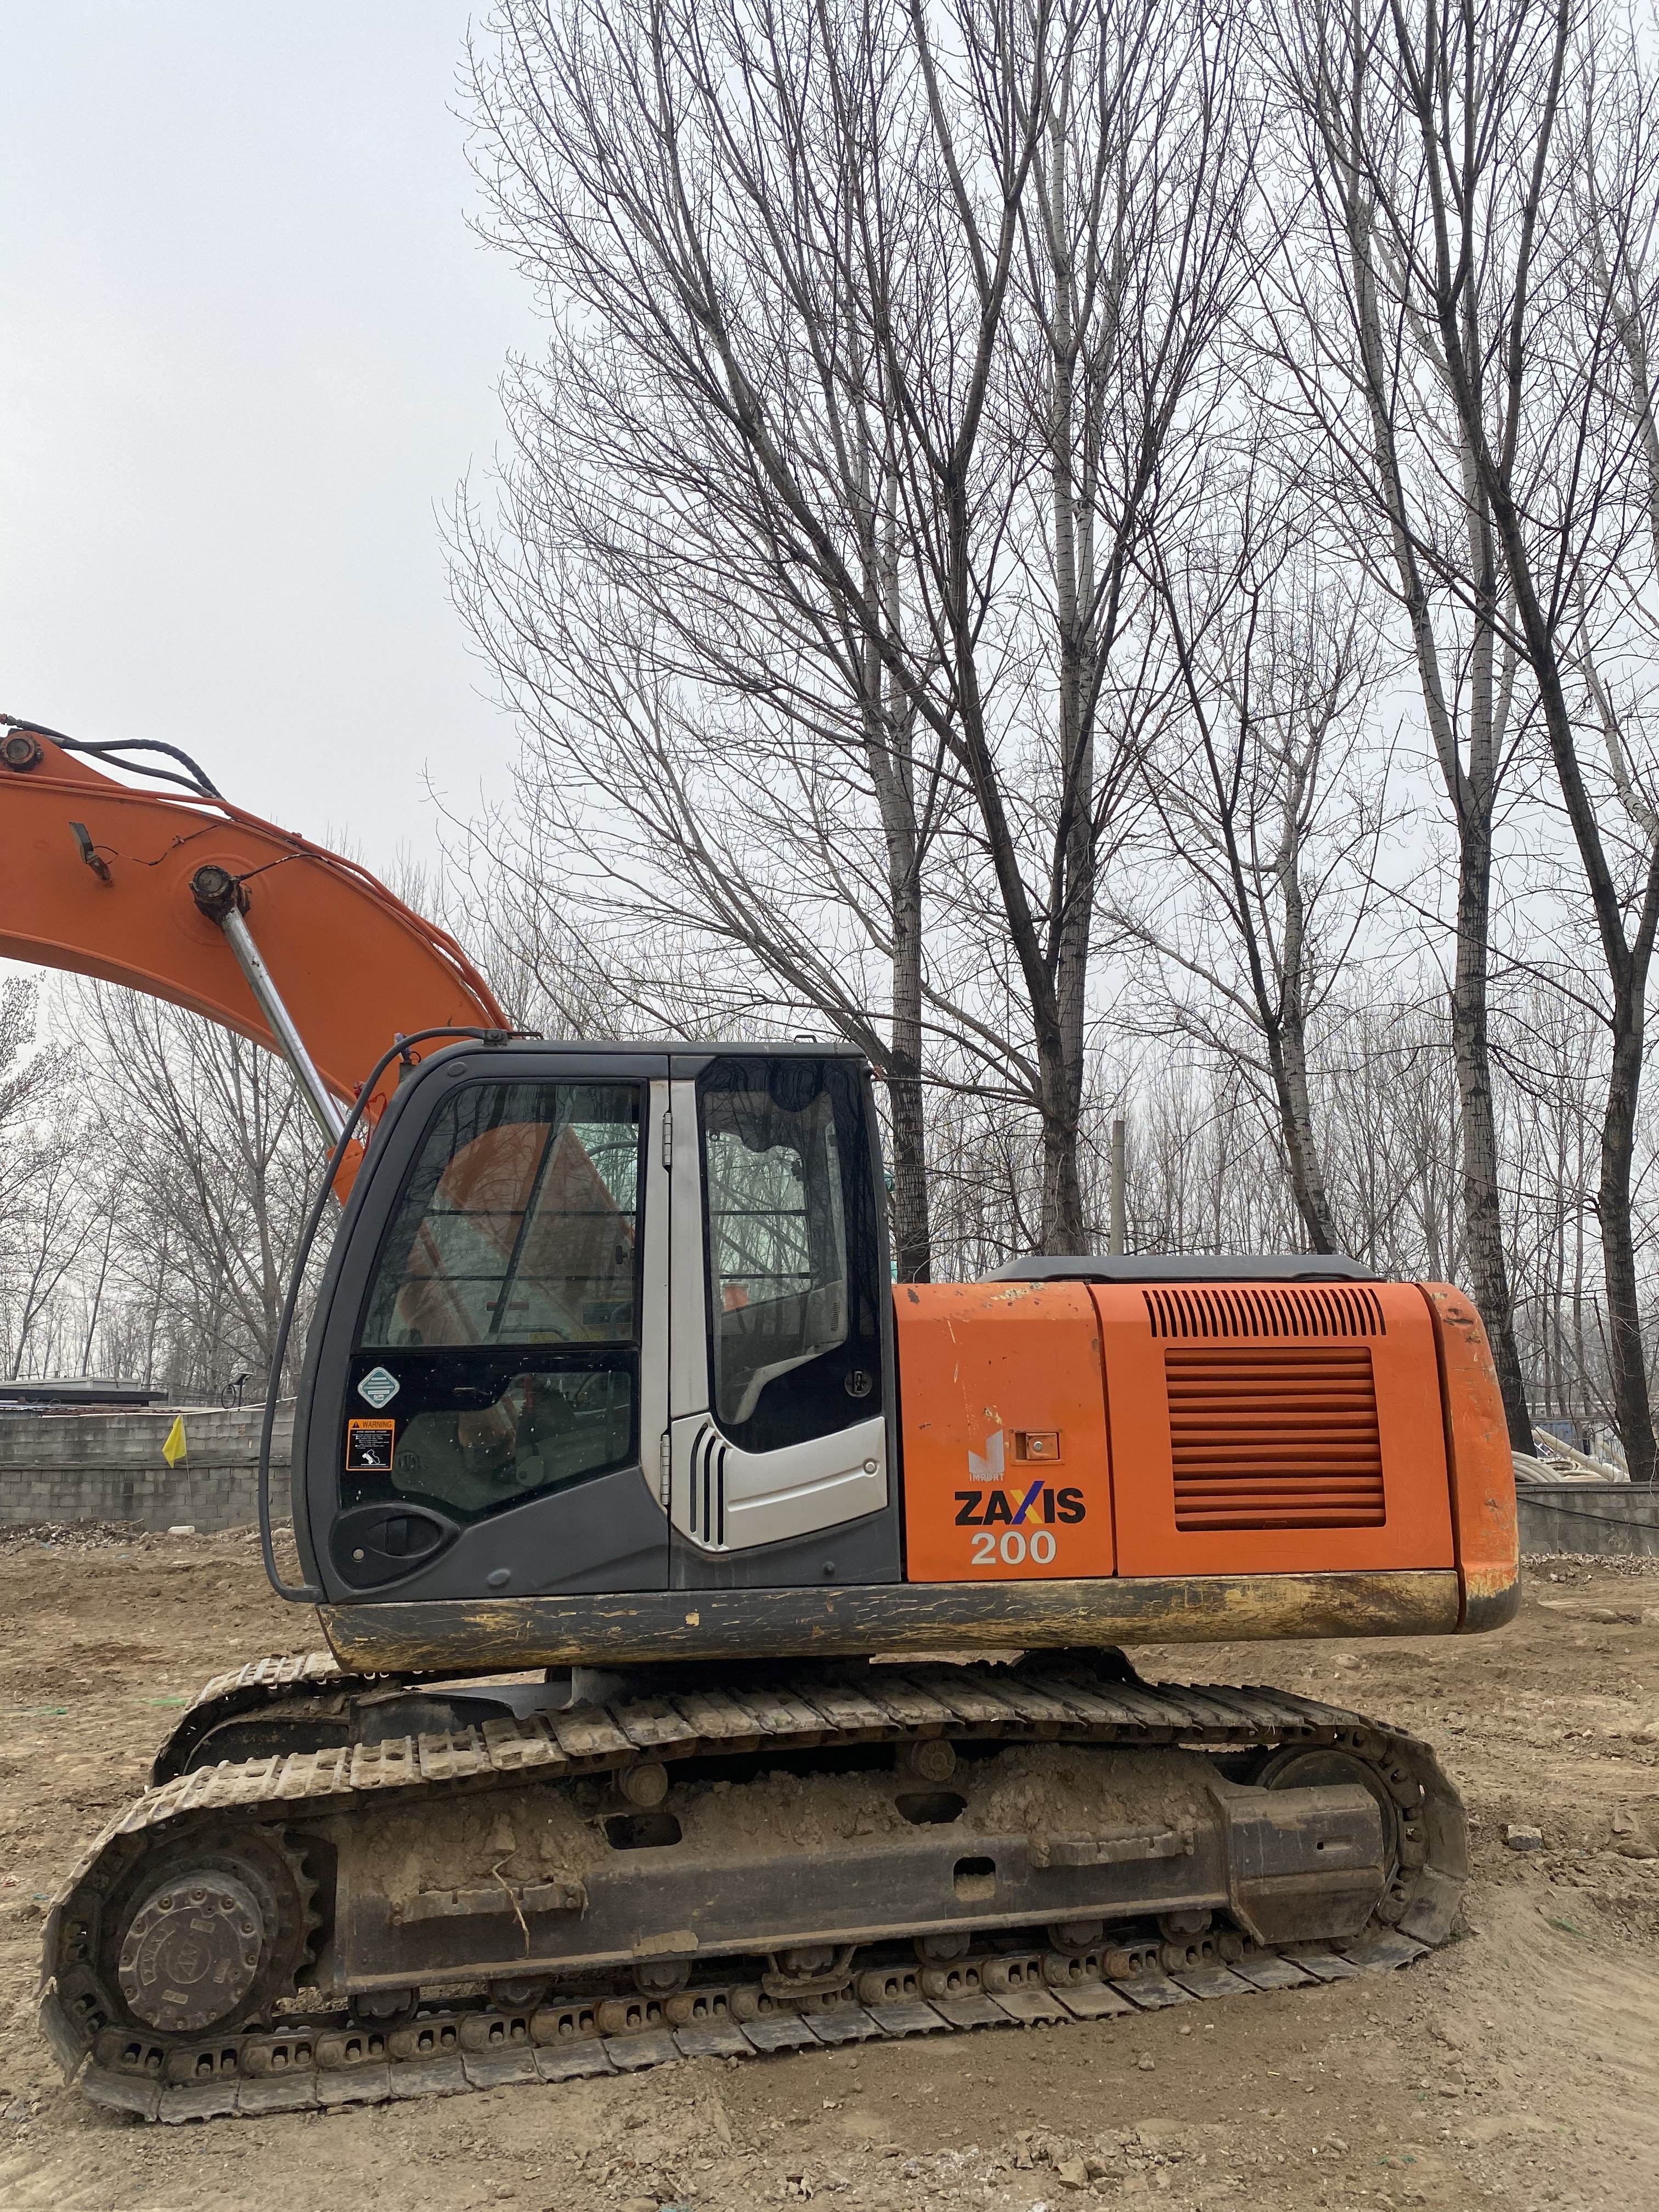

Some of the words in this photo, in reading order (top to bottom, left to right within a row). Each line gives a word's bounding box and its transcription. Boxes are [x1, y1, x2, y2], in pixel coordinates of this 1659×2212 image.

[969, 1474, 1004, 1482] IMPORT
[955, 1480, 1086, 1526] ZAXIS
[971, 1530, 1057, 1564] 200
